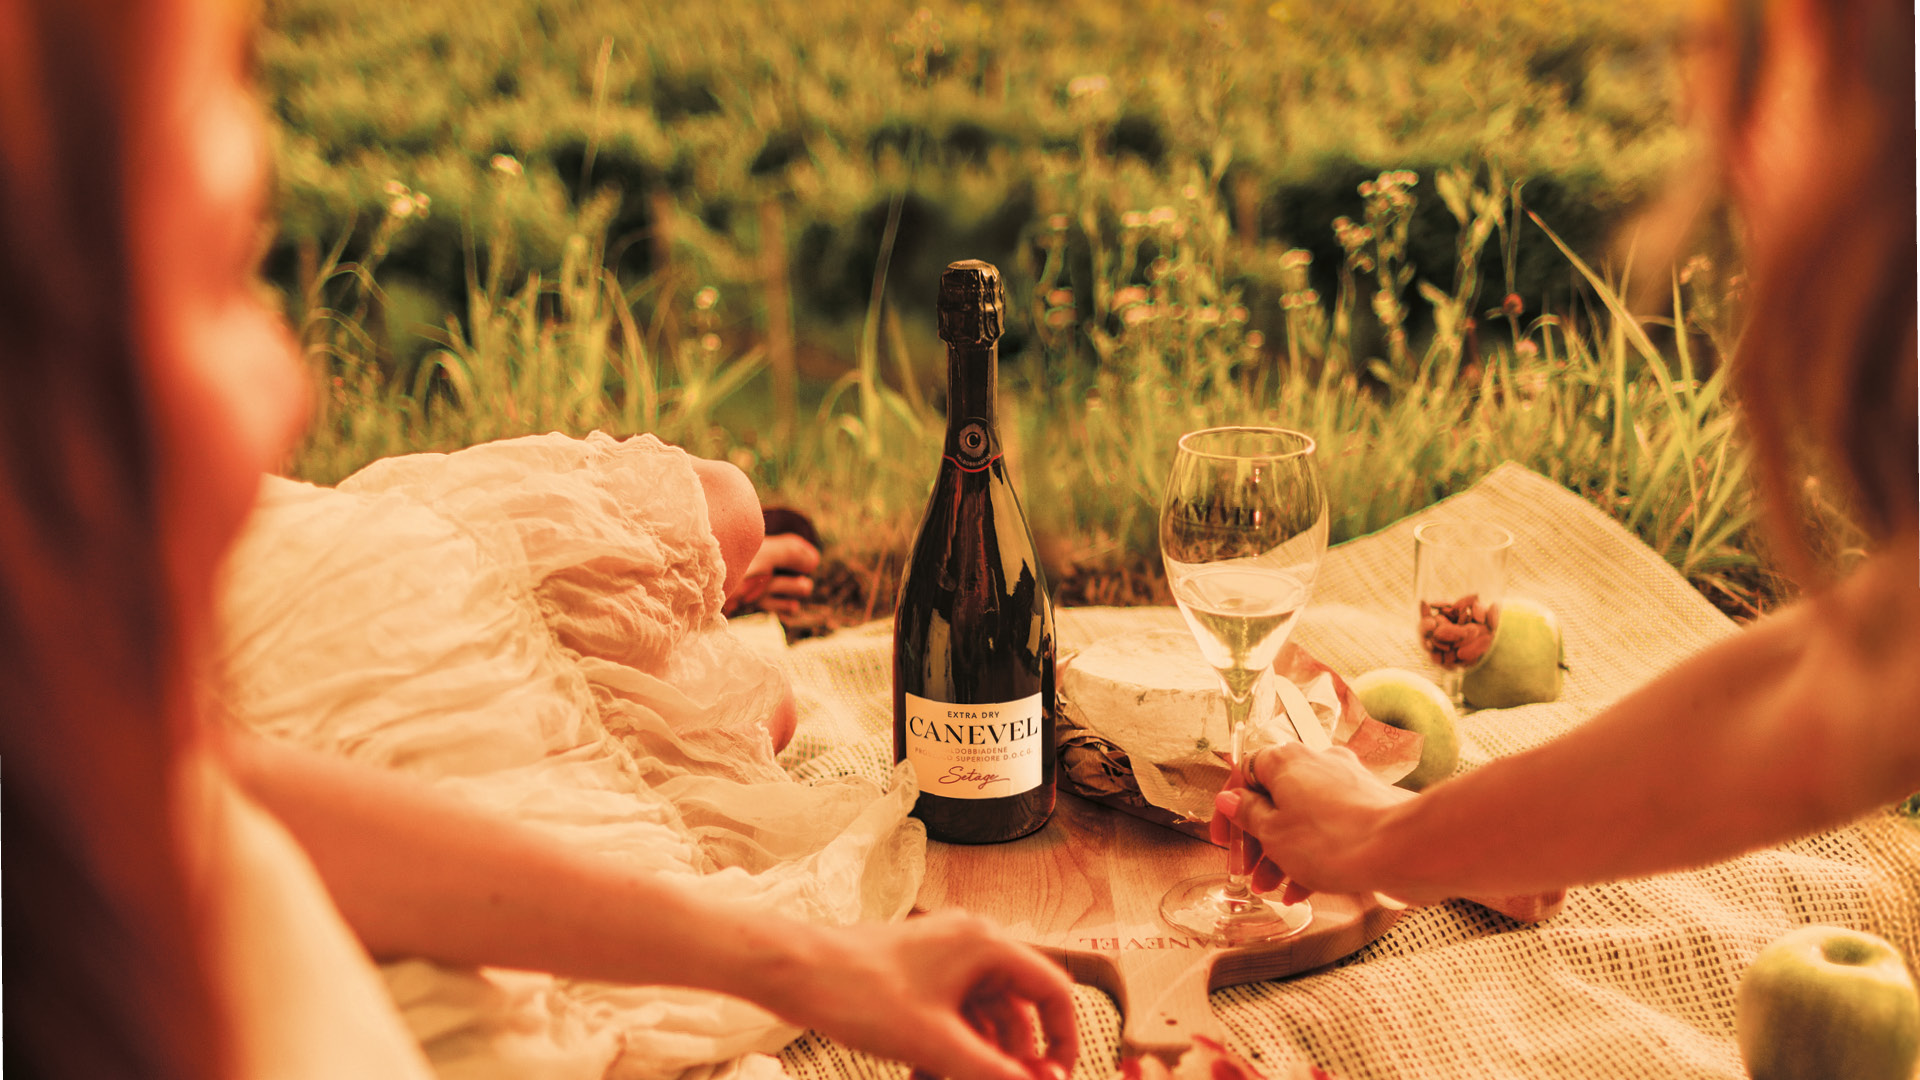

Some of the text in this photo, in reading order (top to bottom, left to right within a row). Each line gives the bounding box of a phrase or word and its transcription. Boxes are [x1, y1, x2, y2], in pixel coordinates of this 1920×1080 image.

[947, 711, 1000, 719] EXTRA DRY
[909, 715, 1038, 745] CANEVEL
[956, 755, 1000, 763] SUPERIORE
